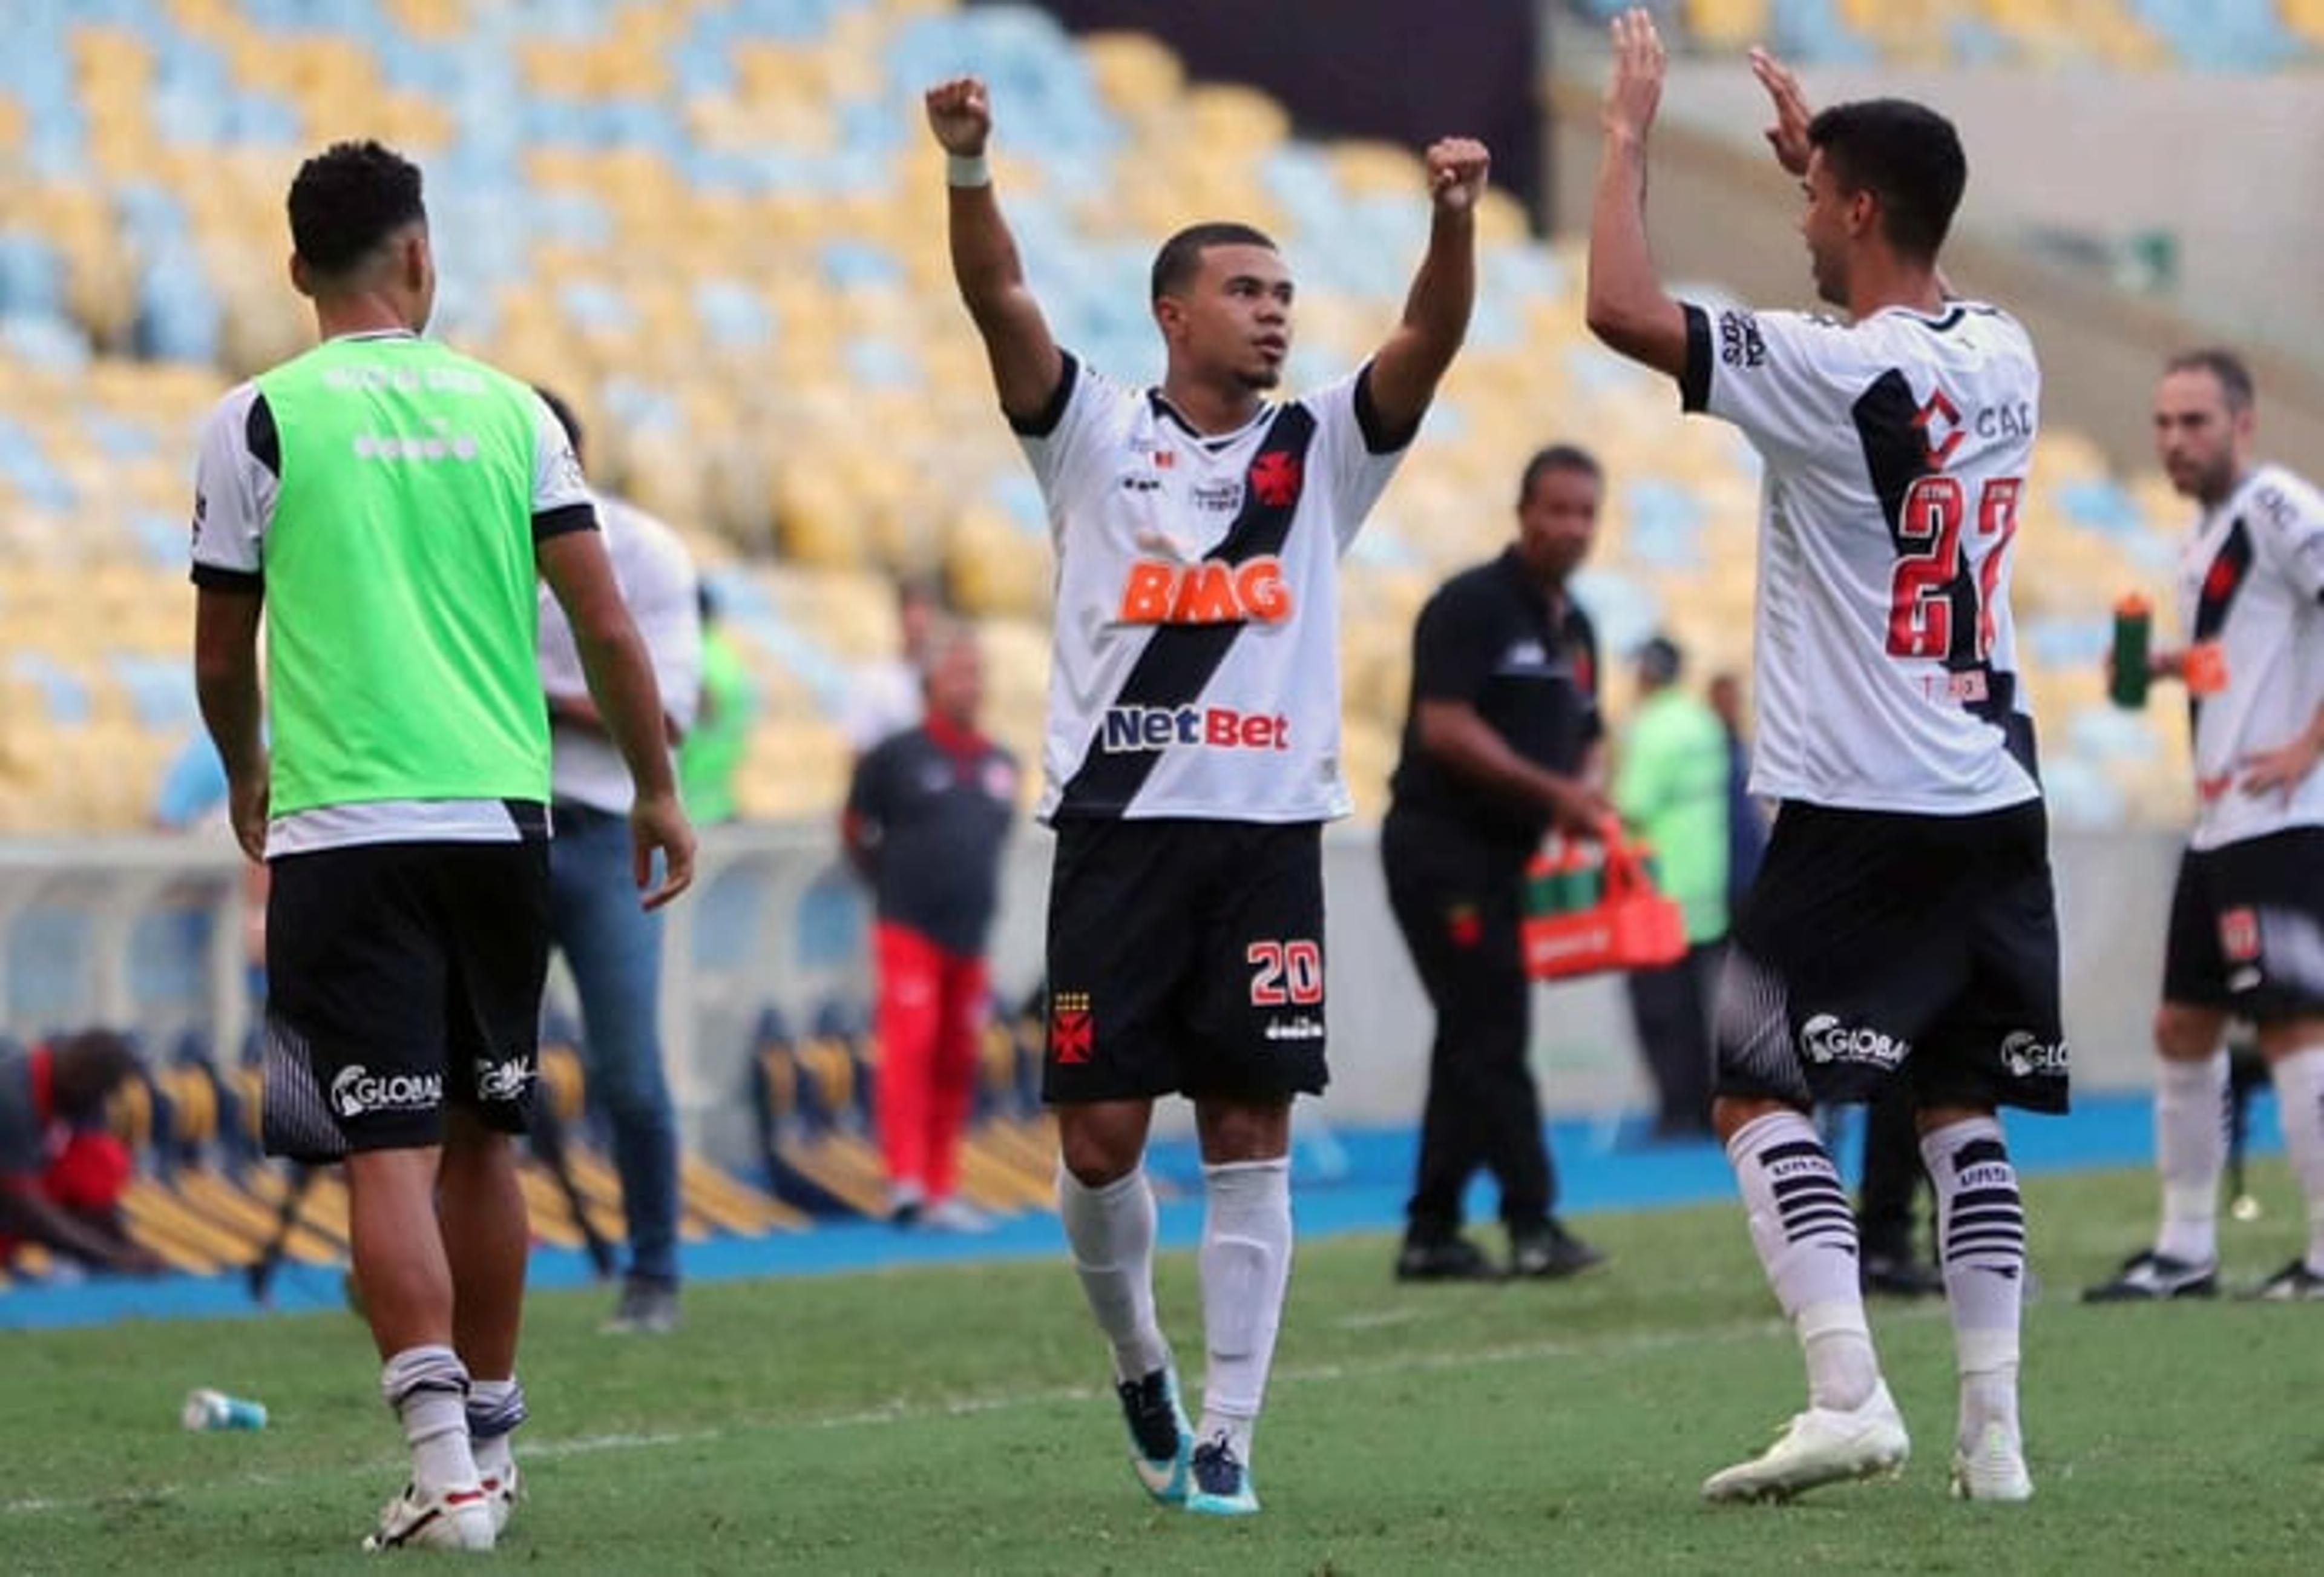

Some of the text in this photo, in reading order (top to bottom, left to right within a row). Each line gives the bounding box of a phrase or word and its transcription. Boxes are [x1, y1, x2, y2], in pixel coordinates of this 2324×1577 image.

[1120, 557, 1295, 624] BMG
[1886, 474, 2023, 661] 27
[1105, 706, 1290, 752] NetBet
[1247, 940, 1323, 1006] 20
